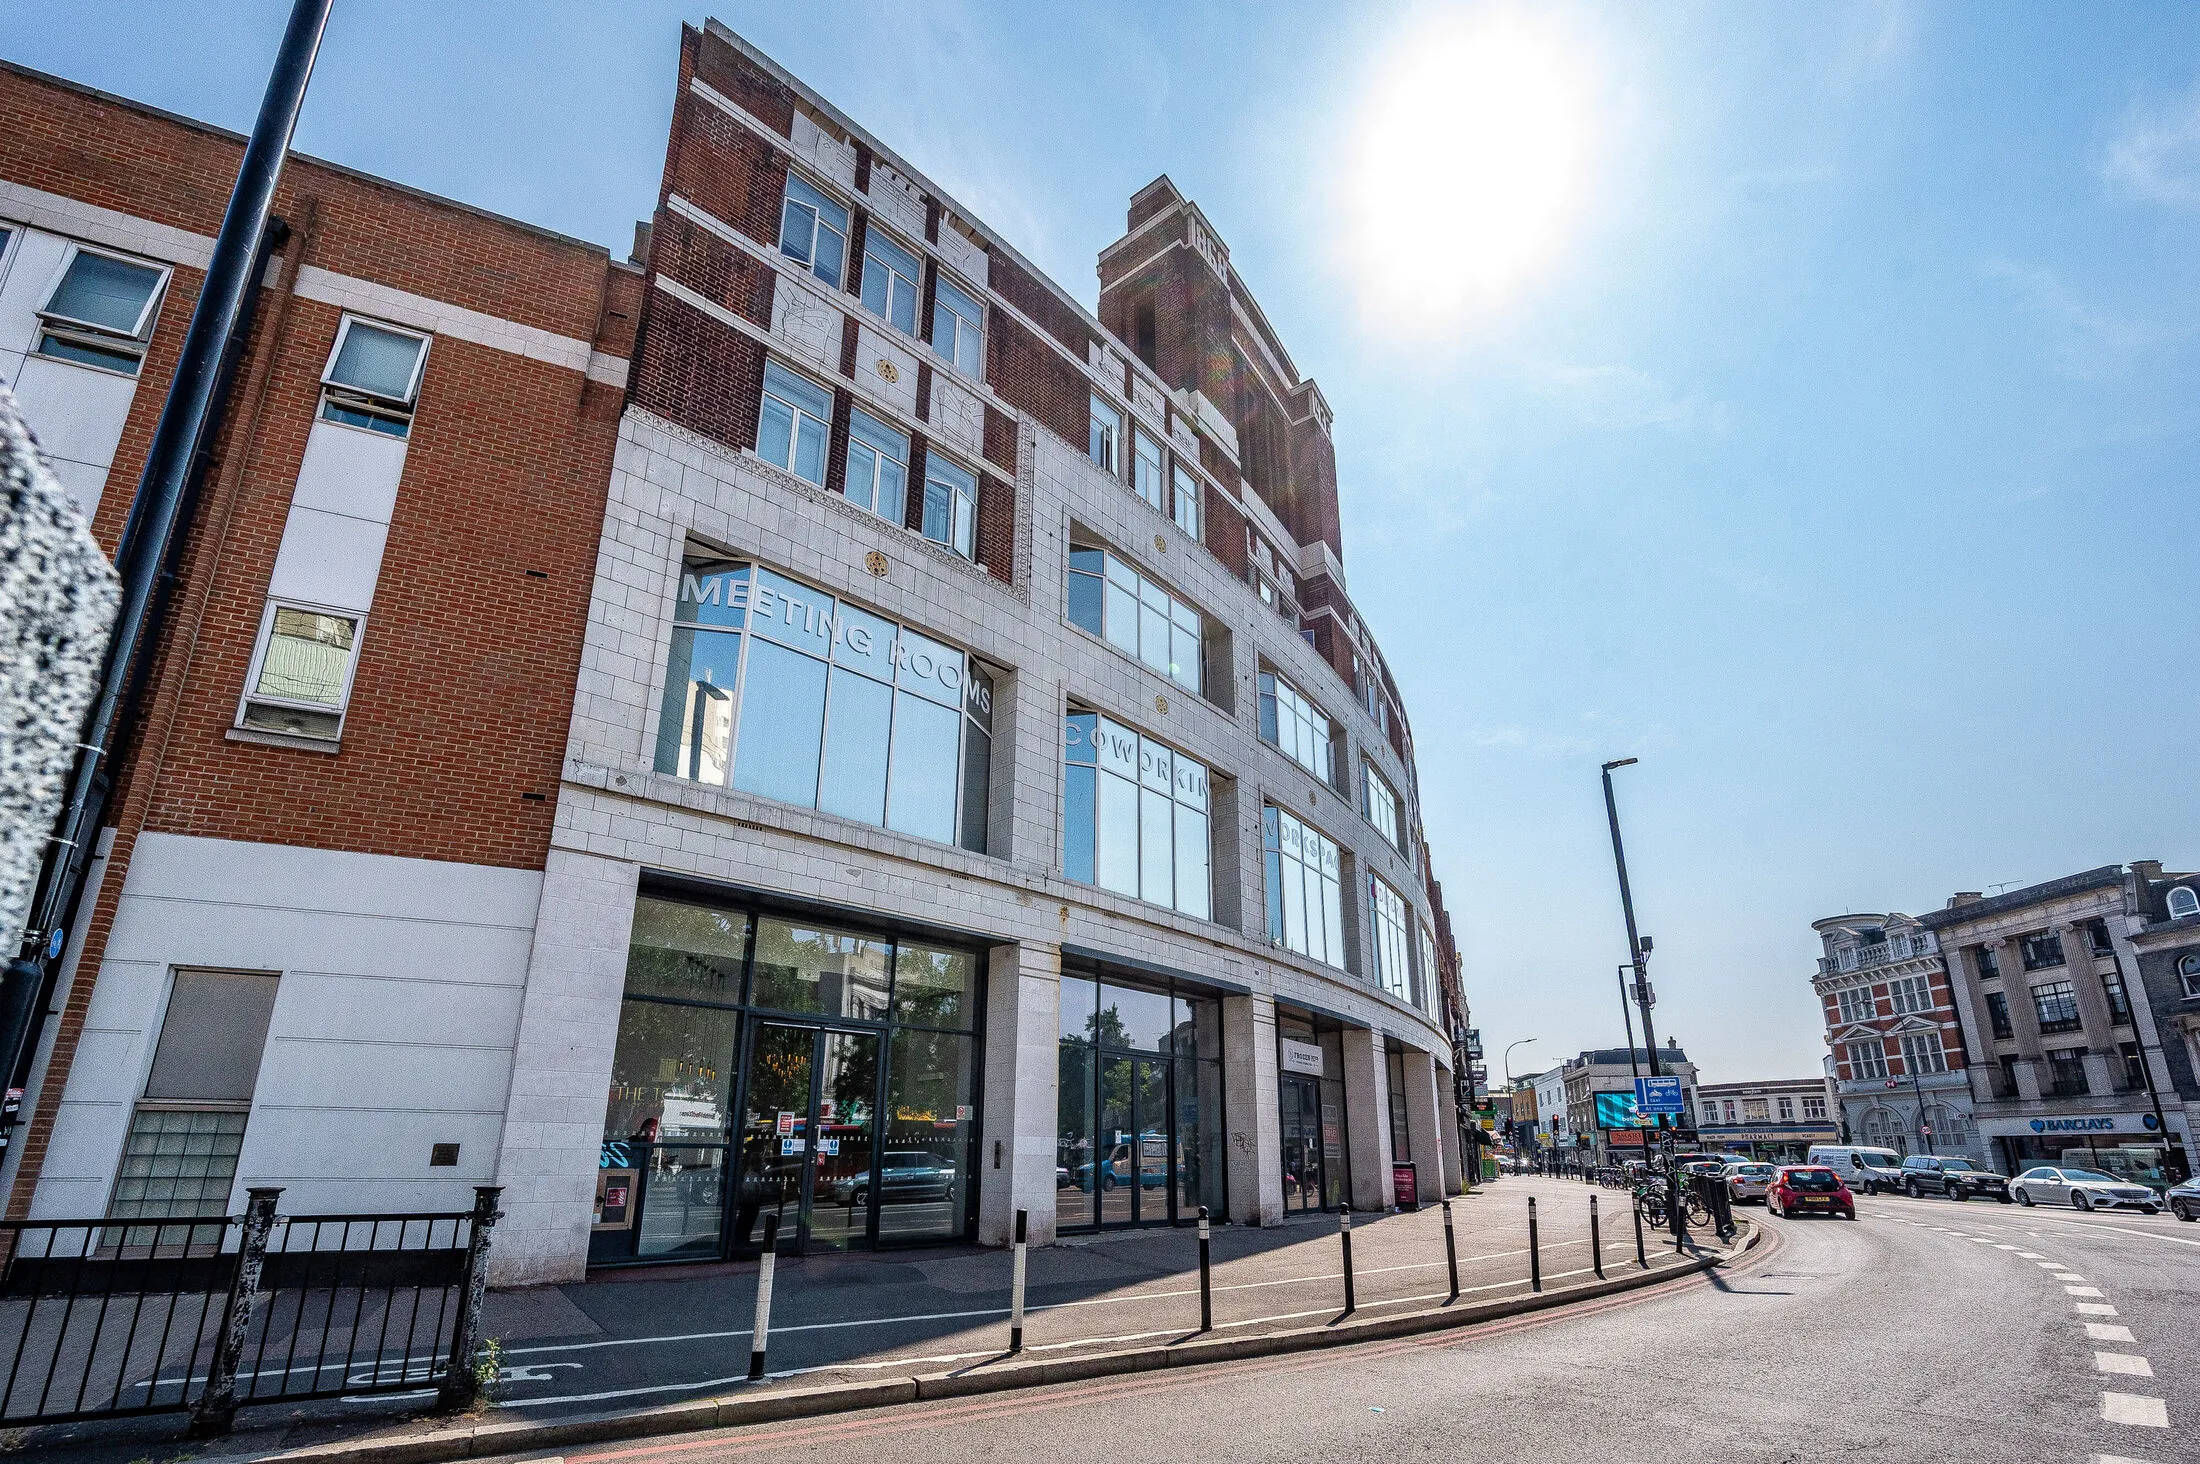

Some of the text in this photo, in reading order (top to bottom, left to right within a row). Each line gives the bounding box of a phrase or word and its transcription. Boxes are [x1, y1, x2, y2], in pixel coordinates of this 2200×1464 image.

[681, 574, 991, 715] MEETING ROOMS
[615, 1087, 647, 1101] THE
[2045, 1117, 2114, 1131] BARCLAYS
